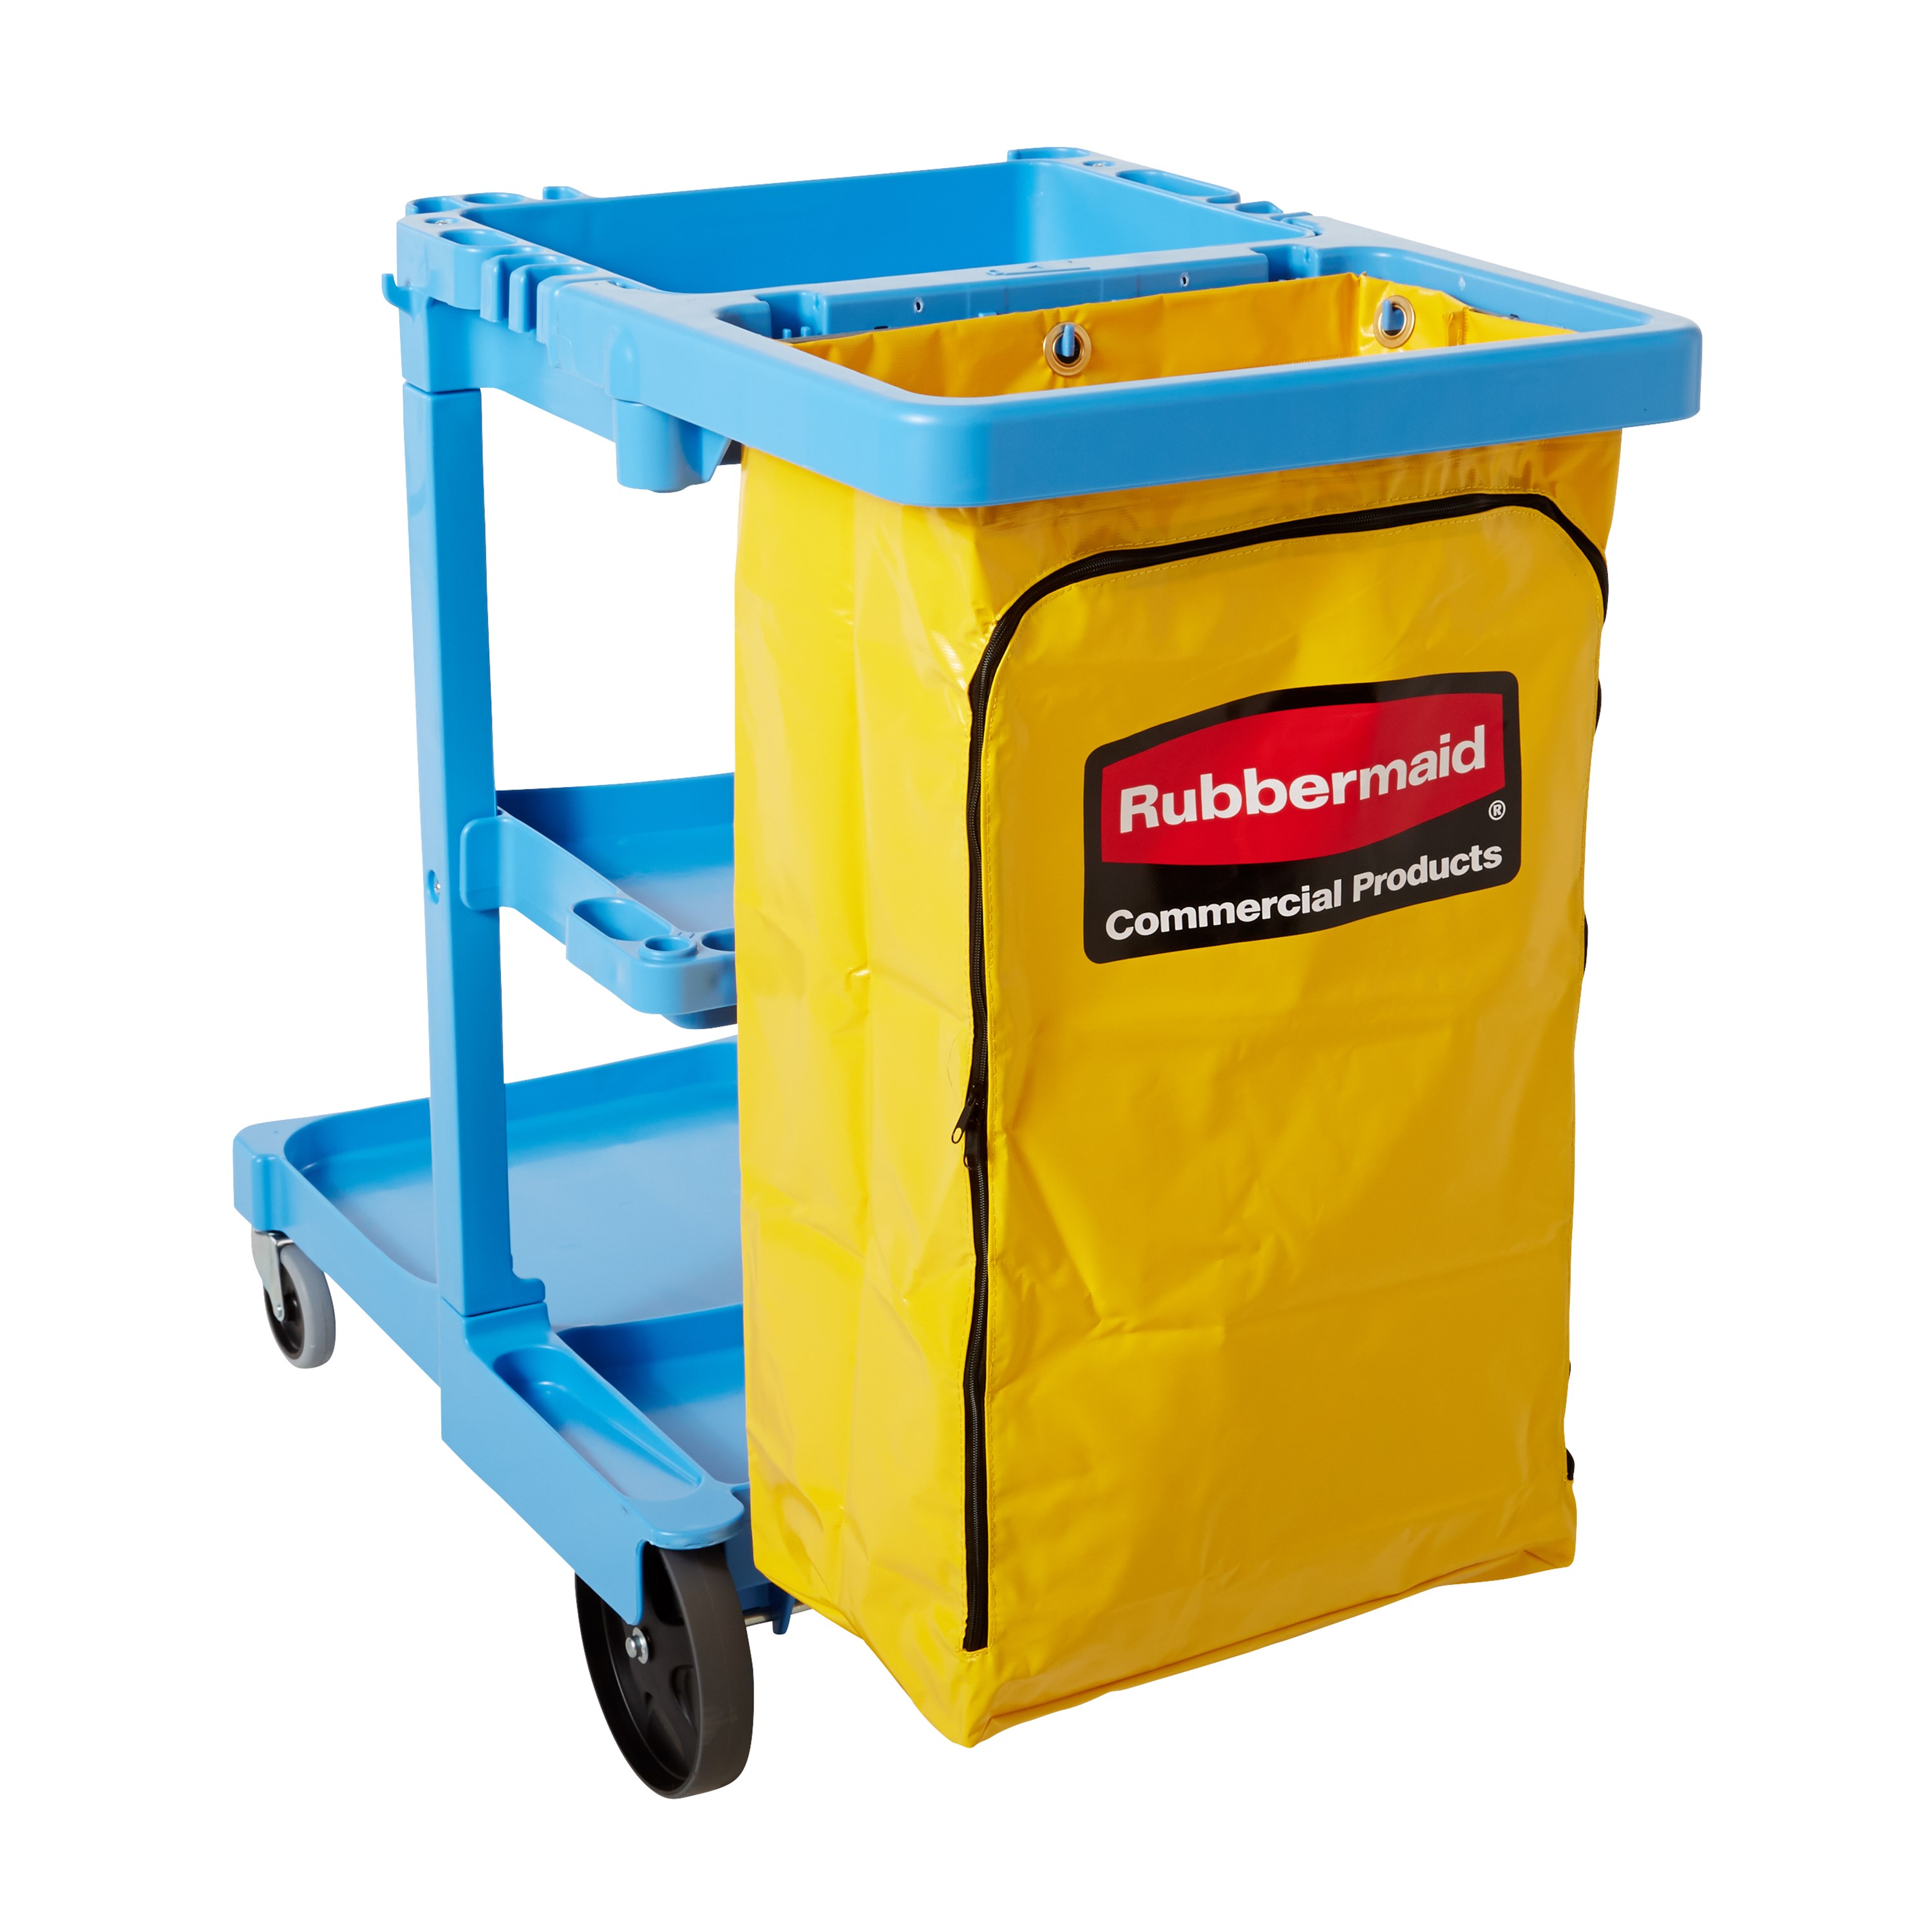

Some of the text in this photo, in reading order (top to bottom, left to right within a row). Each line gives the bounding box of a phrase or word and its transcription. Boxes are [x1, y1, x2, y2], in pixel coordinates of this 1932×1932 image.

[1120, 724, 1486, 834] Rubbermaid
[1106, 844, 1502, 940] Commercial Products
